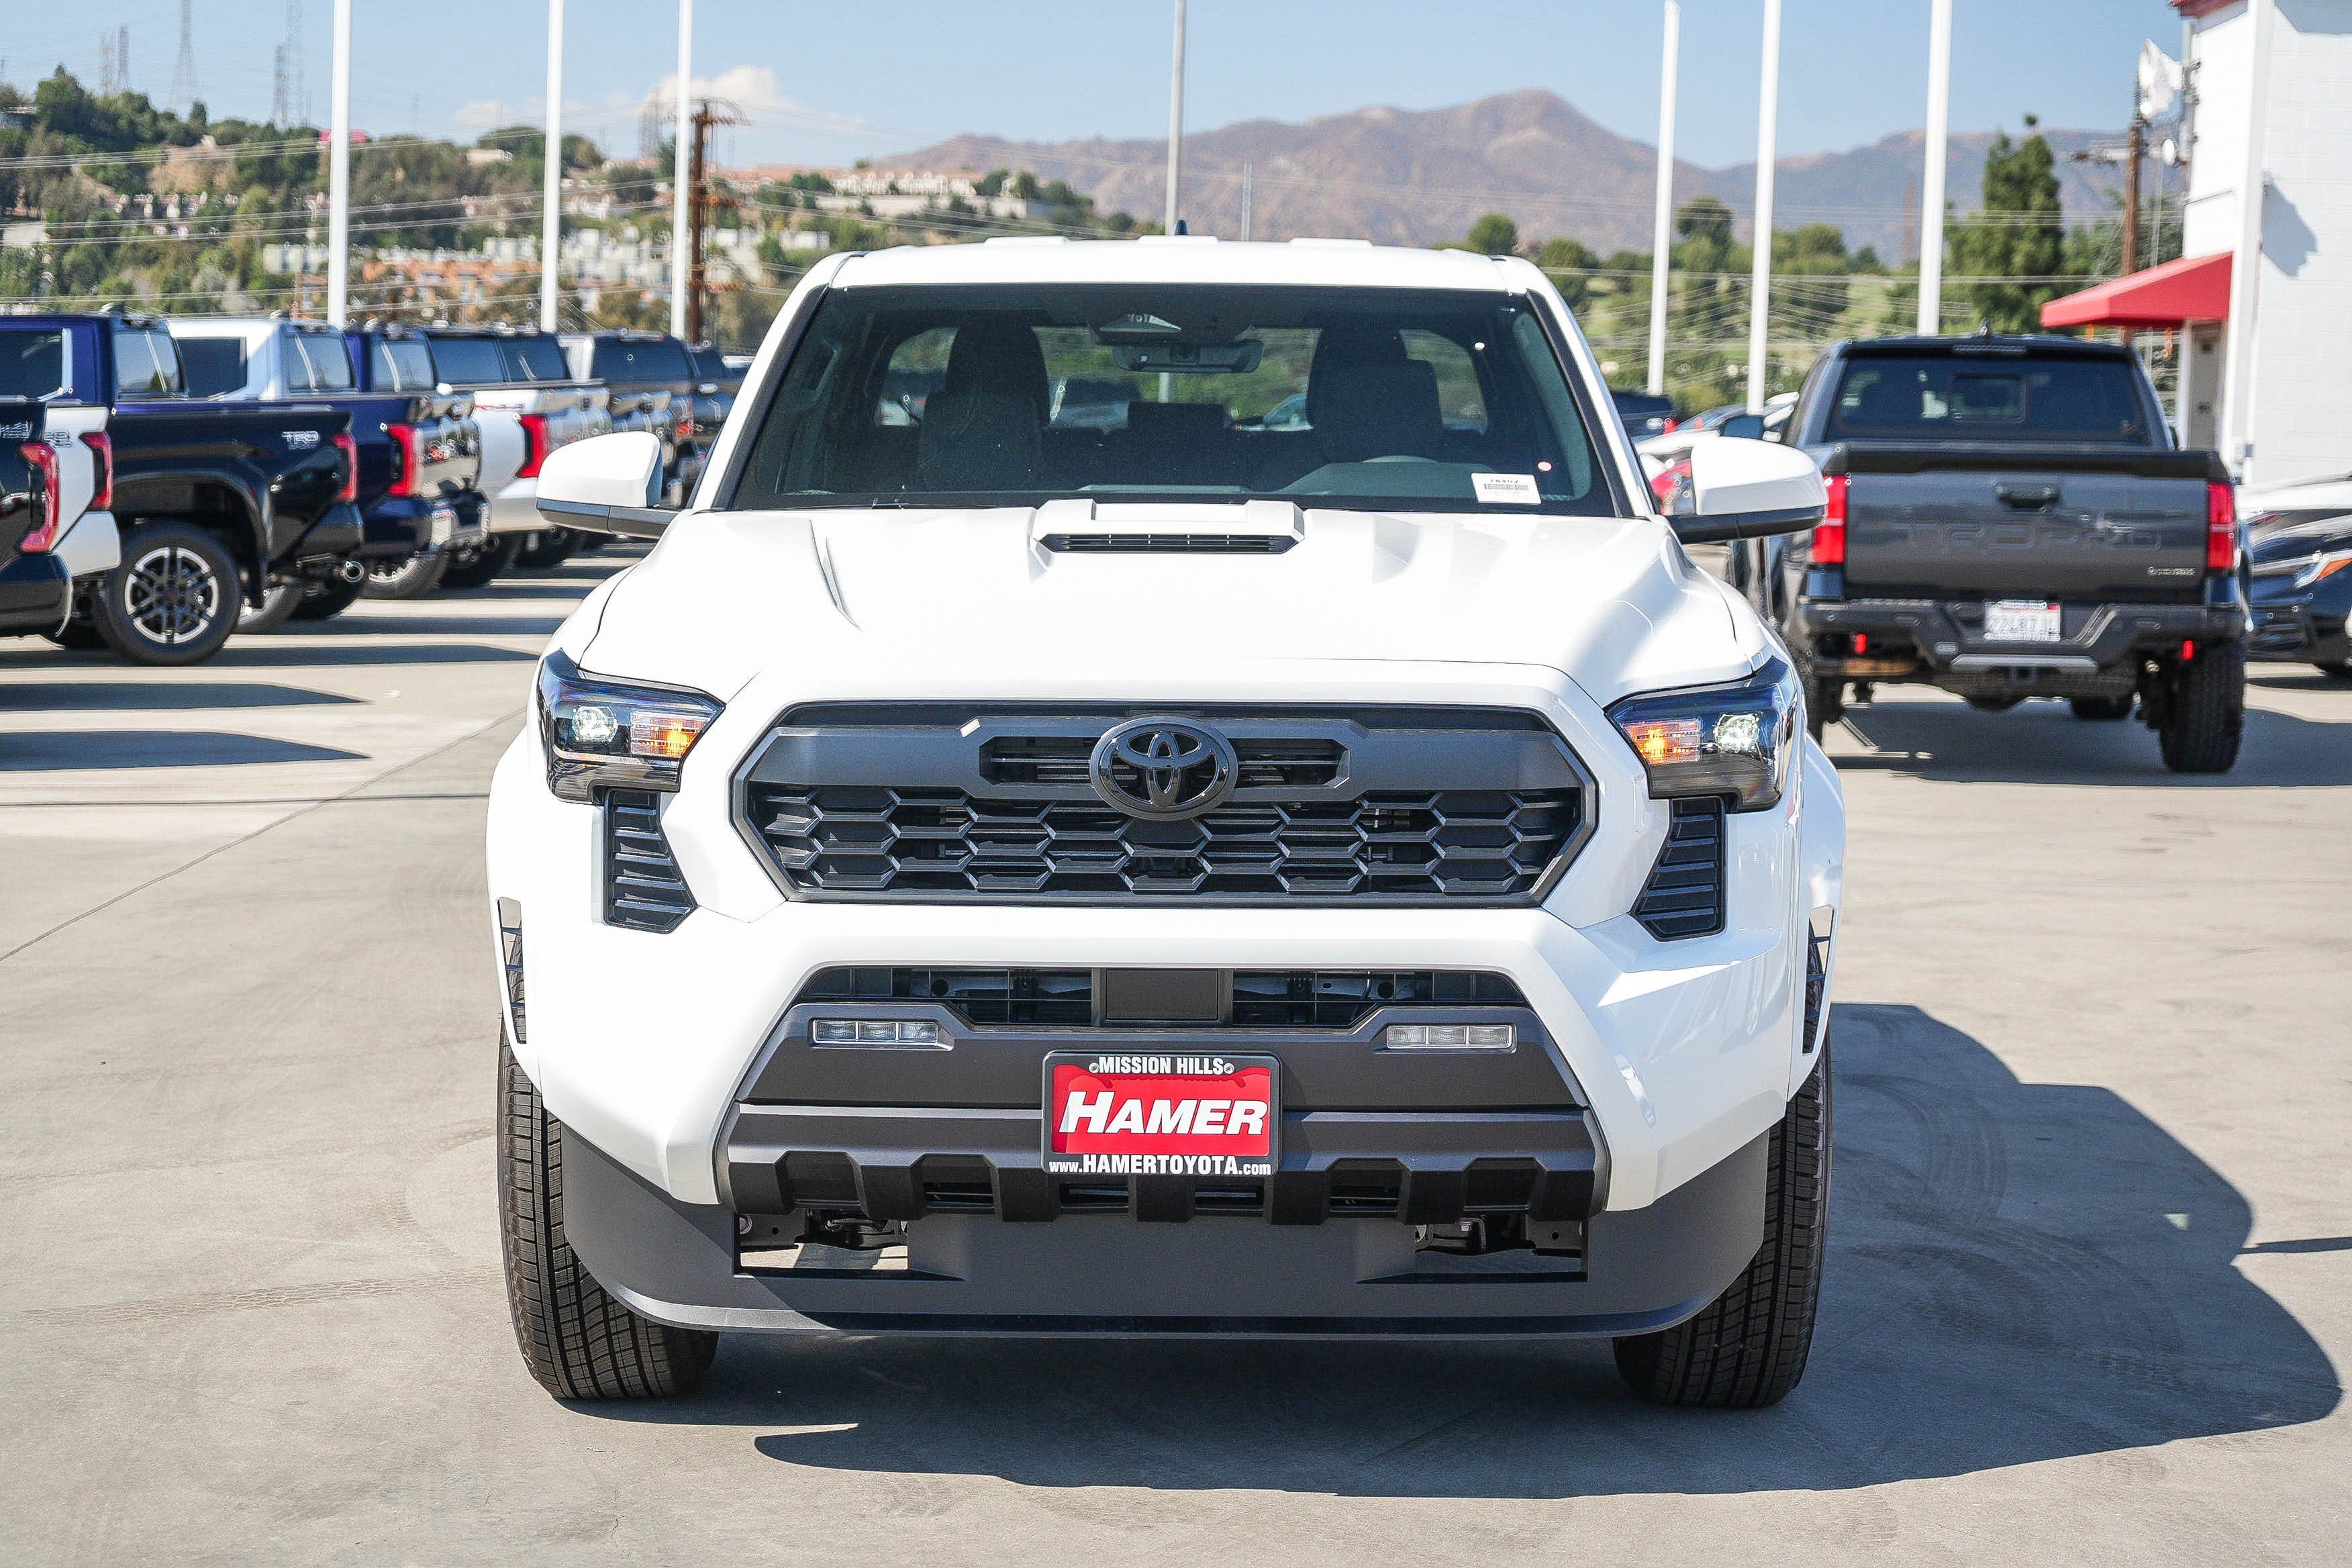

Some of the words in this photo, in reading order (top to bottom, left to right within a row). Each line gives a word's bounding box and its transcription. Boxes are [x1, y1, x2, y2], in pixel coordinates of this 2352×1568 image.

[281, 430, 320, 444] TRD
[1098, 1056, 1174, 1074] MISSION
[1177, 1057, 1224, 1075] HILLS
[1059, 1091, 1269, 1135] HAMER
[1049, 1154, 1271, 1175] www.HAMERTOYOTA.com
